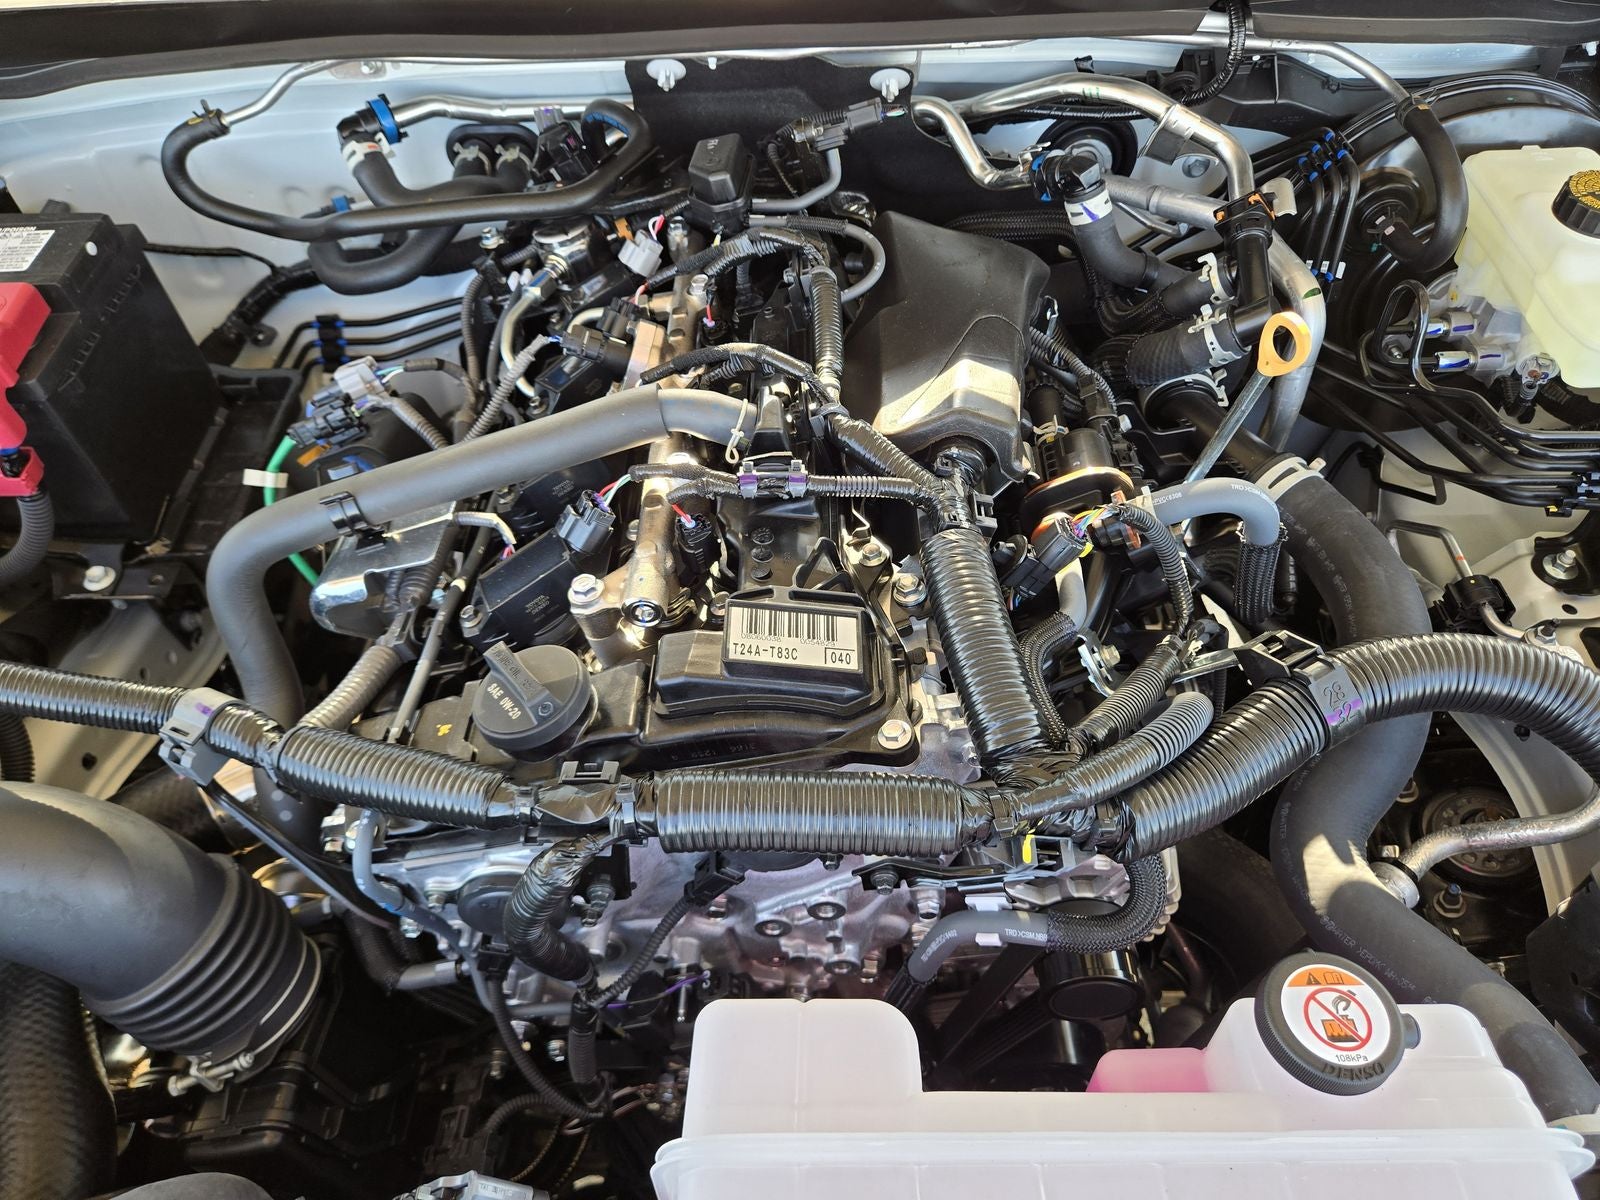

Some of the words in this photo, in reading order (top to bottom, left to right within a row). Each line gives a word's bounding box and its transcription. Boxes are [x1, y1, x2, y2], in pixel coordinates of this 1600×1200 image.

[733, 642, 798, 661] T24A-T83C
[830, 651, 851, 665] 040
[487, 683, 504, 700] SAE
[499, 696, 522, 720] 0W-20
[1335, 1053, 1369, 1063] 108kPa
[1321, 1062, 1386, 1081] DENSO
